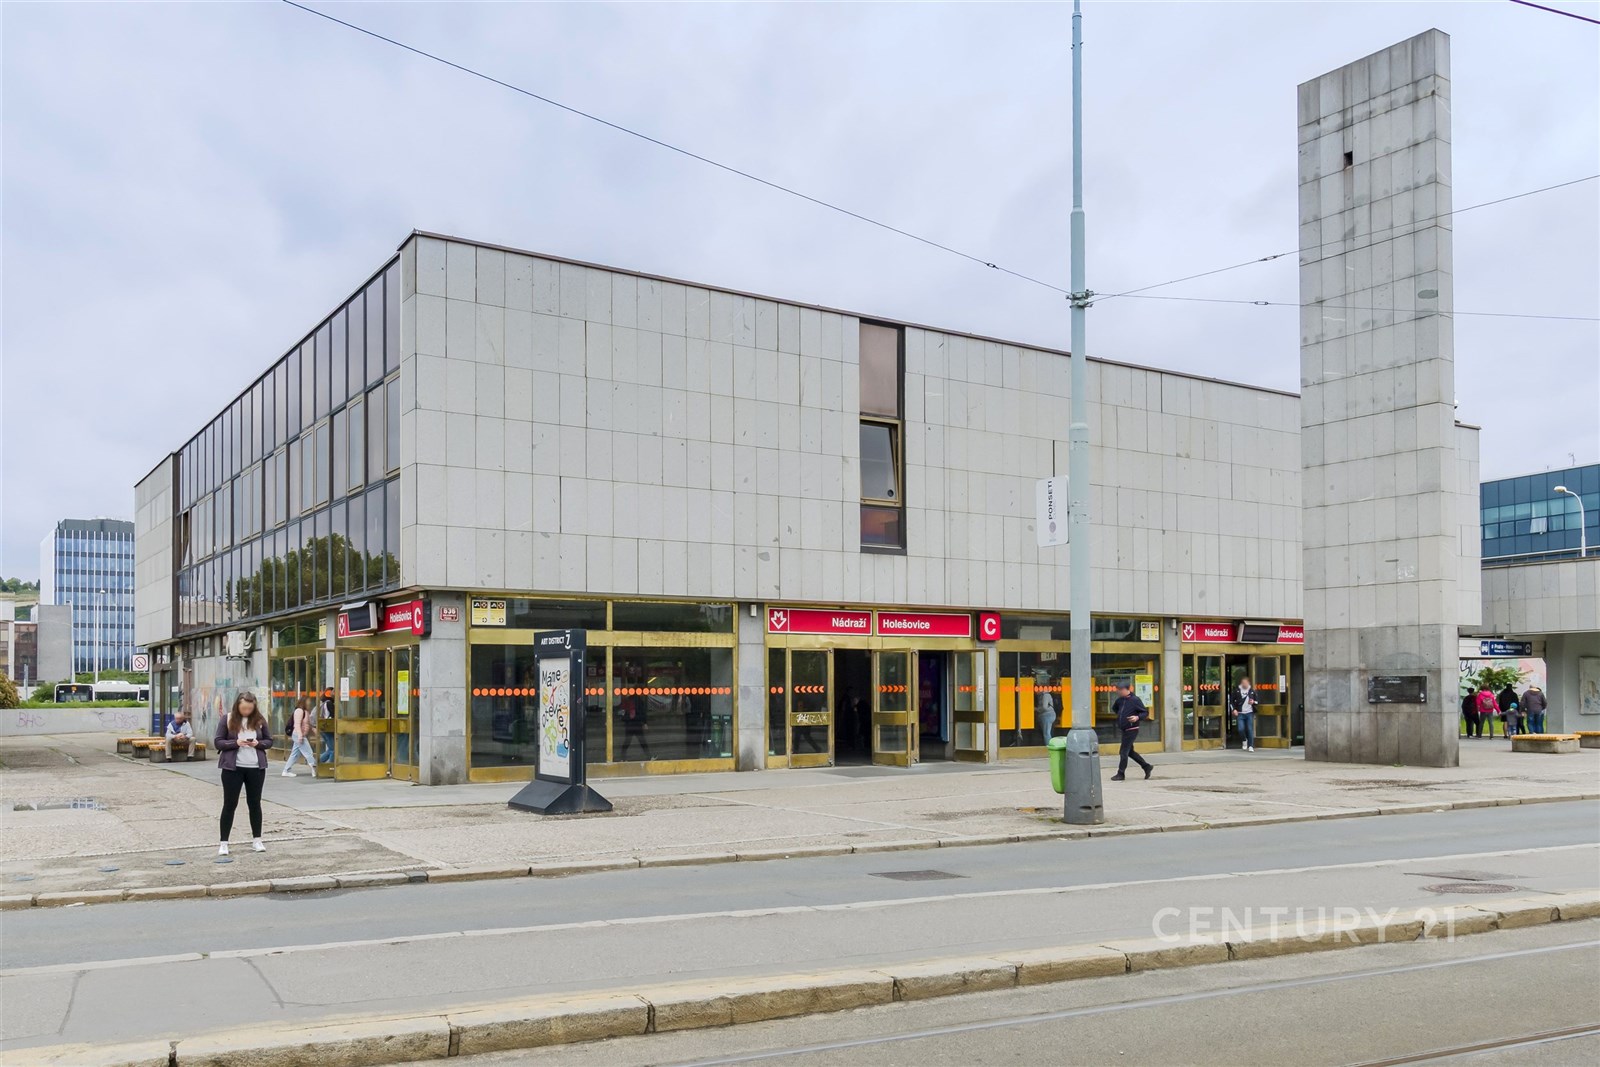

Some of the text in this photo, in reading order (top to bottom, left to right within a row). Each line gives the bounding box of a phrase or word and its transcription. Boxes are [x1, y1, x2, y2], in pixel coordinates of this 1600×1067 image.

[389, 610, 413, 623] Holešovice
[414, 607, 422, 629] C
[831, 617, 930, 629] Nádraží Holešovice
[983, 617, 996, 636] C
[1204, 628, 1229, 637] Nádraží
[540, 637, 548, 646] ART
[548, 635, 565, 645] DISTRICT
